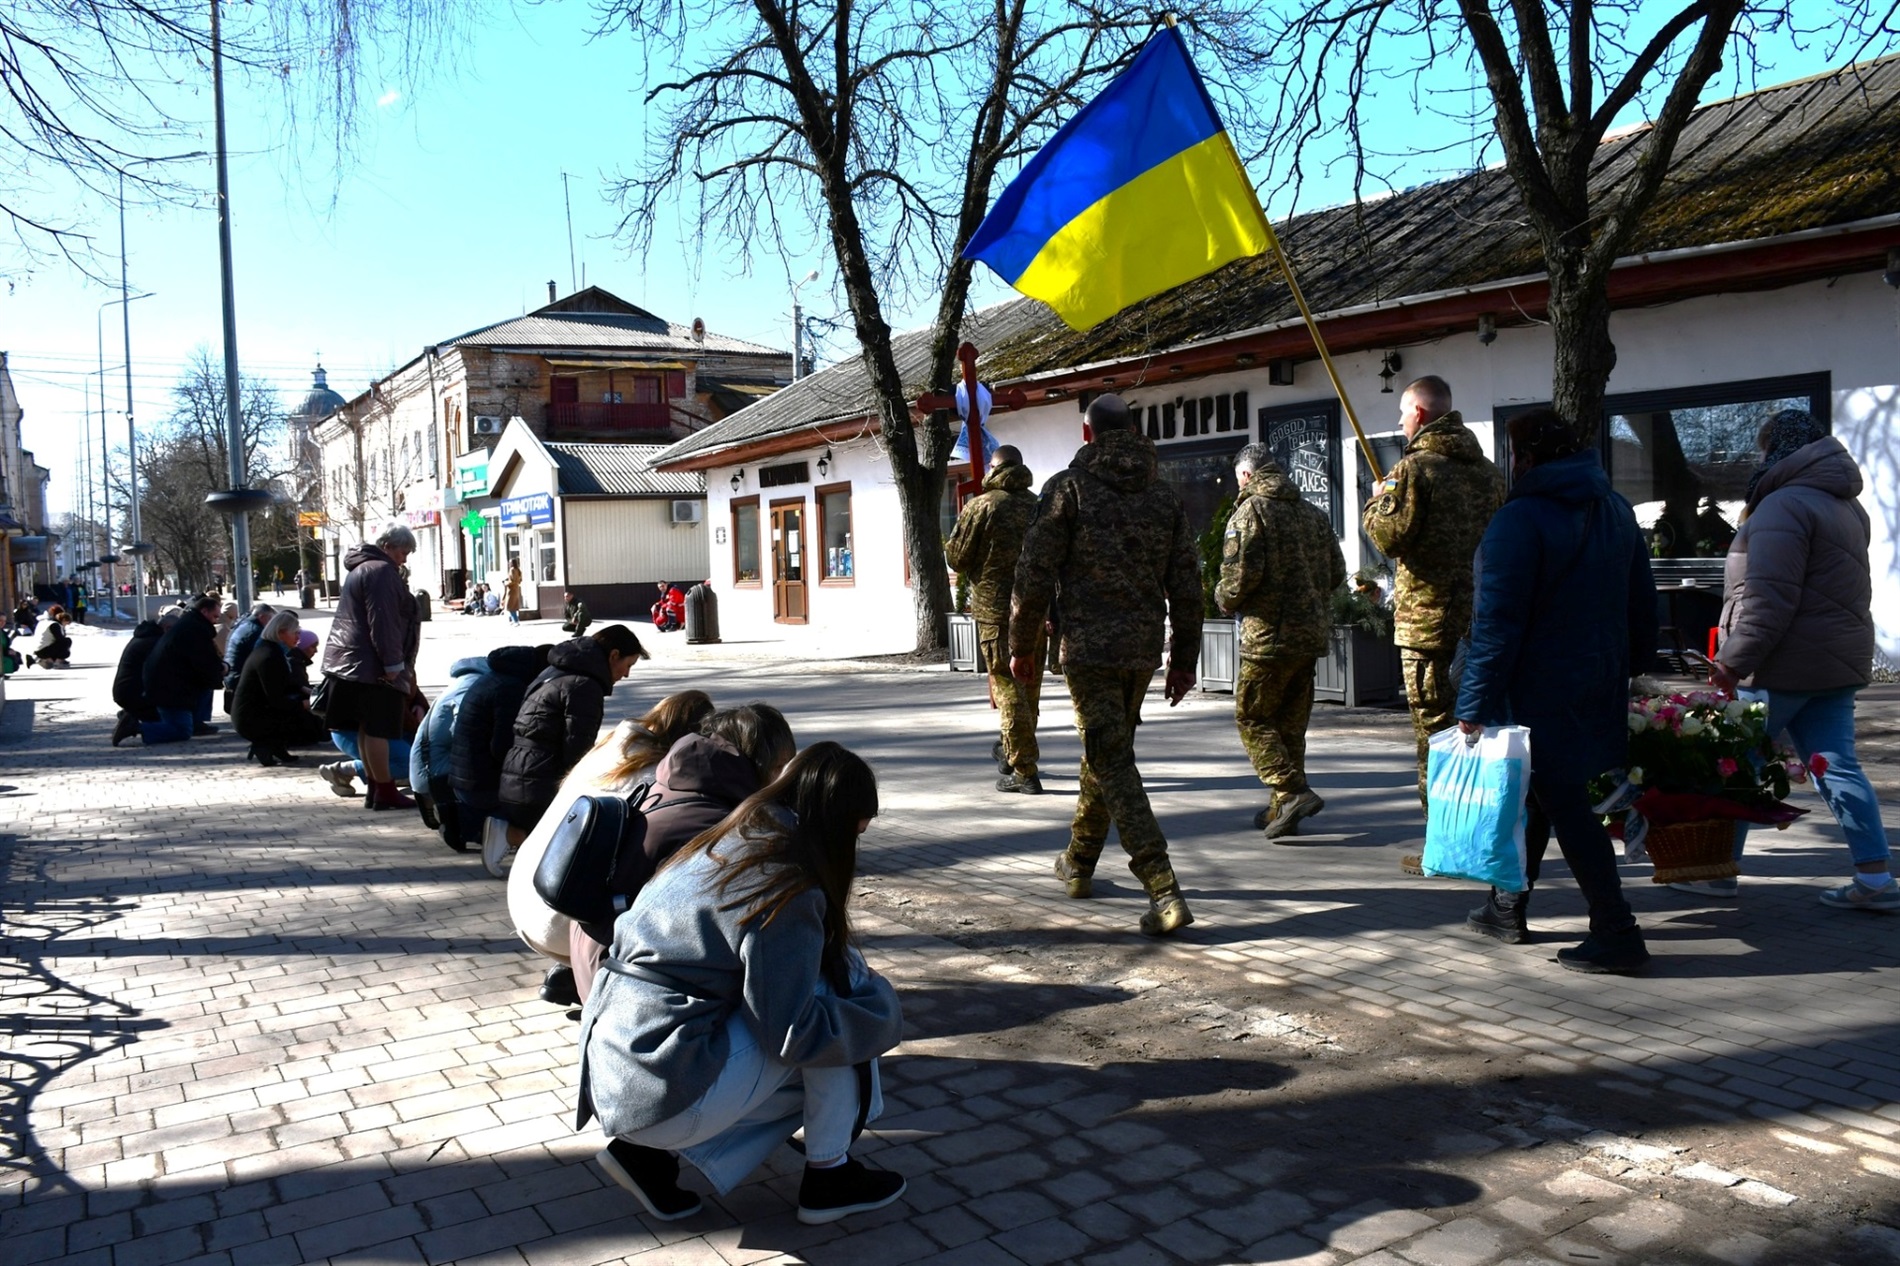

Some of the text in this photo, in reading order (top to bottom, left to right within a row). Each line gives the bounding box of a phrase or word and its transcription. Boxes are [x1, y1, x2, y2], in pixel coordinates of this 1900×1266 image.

[1272, 420, 1303, 443] GOGOL
[1292, 432, 1326, 448] POINT
[1295, 469, 1328, 492] CAKES
[501, 494, 549, 516] ТРИКОТАЖ
